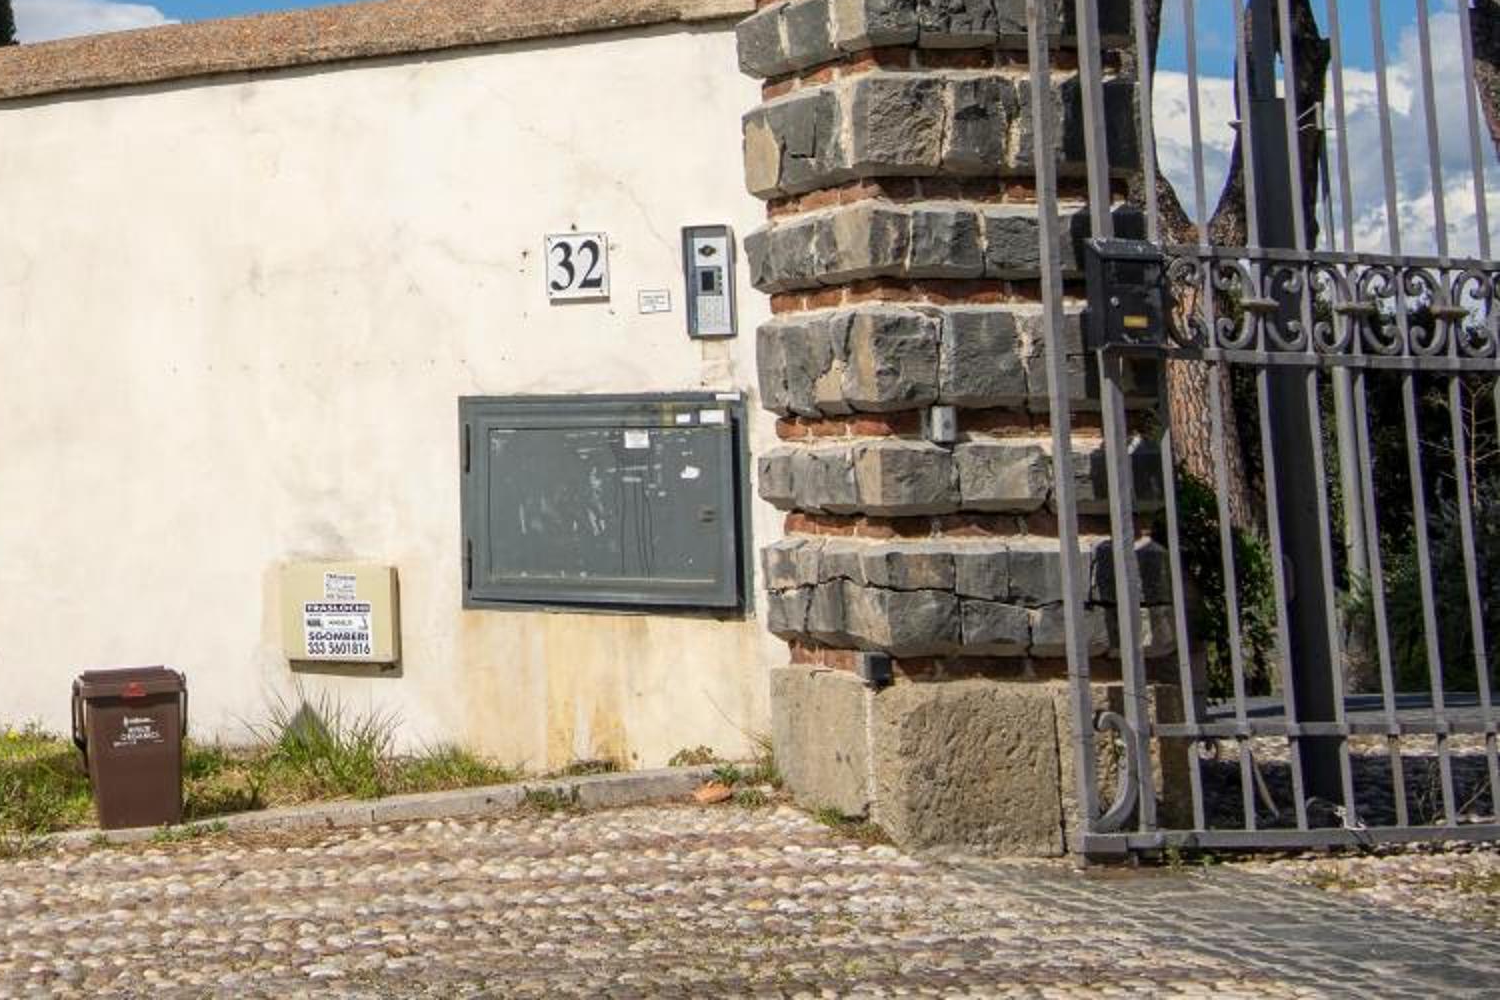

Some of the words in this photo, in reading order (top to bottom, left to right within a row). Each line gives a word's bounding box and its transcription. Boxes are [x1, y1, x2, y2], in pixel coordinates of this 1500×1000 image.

[550, 239, 603, 290] 32
[308, 631, 368, 641] SGOMBERI
[307, 642, 326, 654] 333
[328, 642, 370, 655] 5601816
